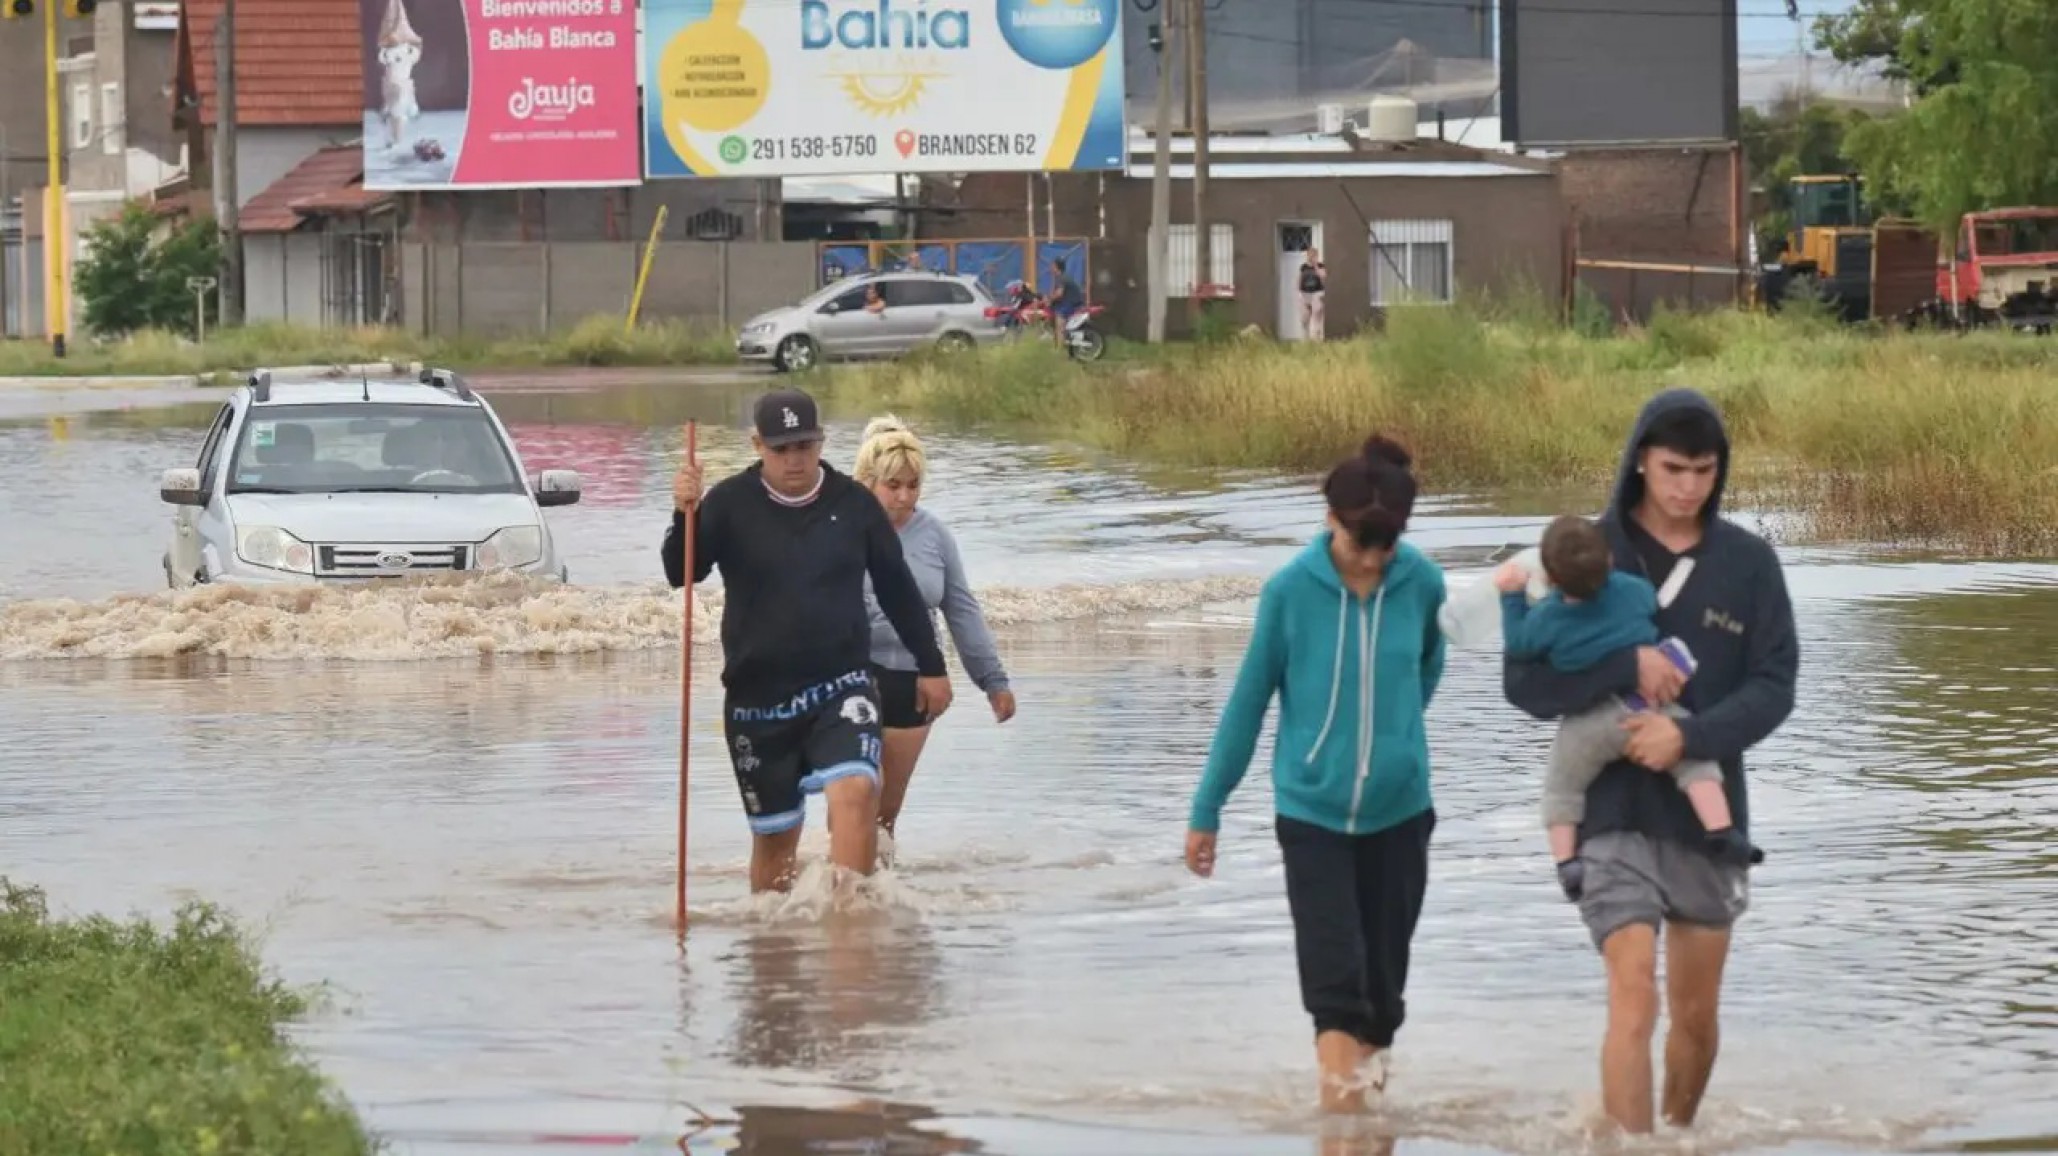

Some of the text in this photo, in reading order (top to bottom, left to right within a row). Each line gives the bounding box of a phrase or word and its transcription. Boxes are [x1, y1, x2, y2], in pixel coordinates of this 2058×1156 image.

[481, 0, 603, 17] Bienvenidos
[489, 25, 616, 50] Bahía Blanca
[507, 76, 596, 119] Jauja
[752, 135, 877, 160] 291 538-5750
[918, 133, 1037, 156] BRANDSEN 62
